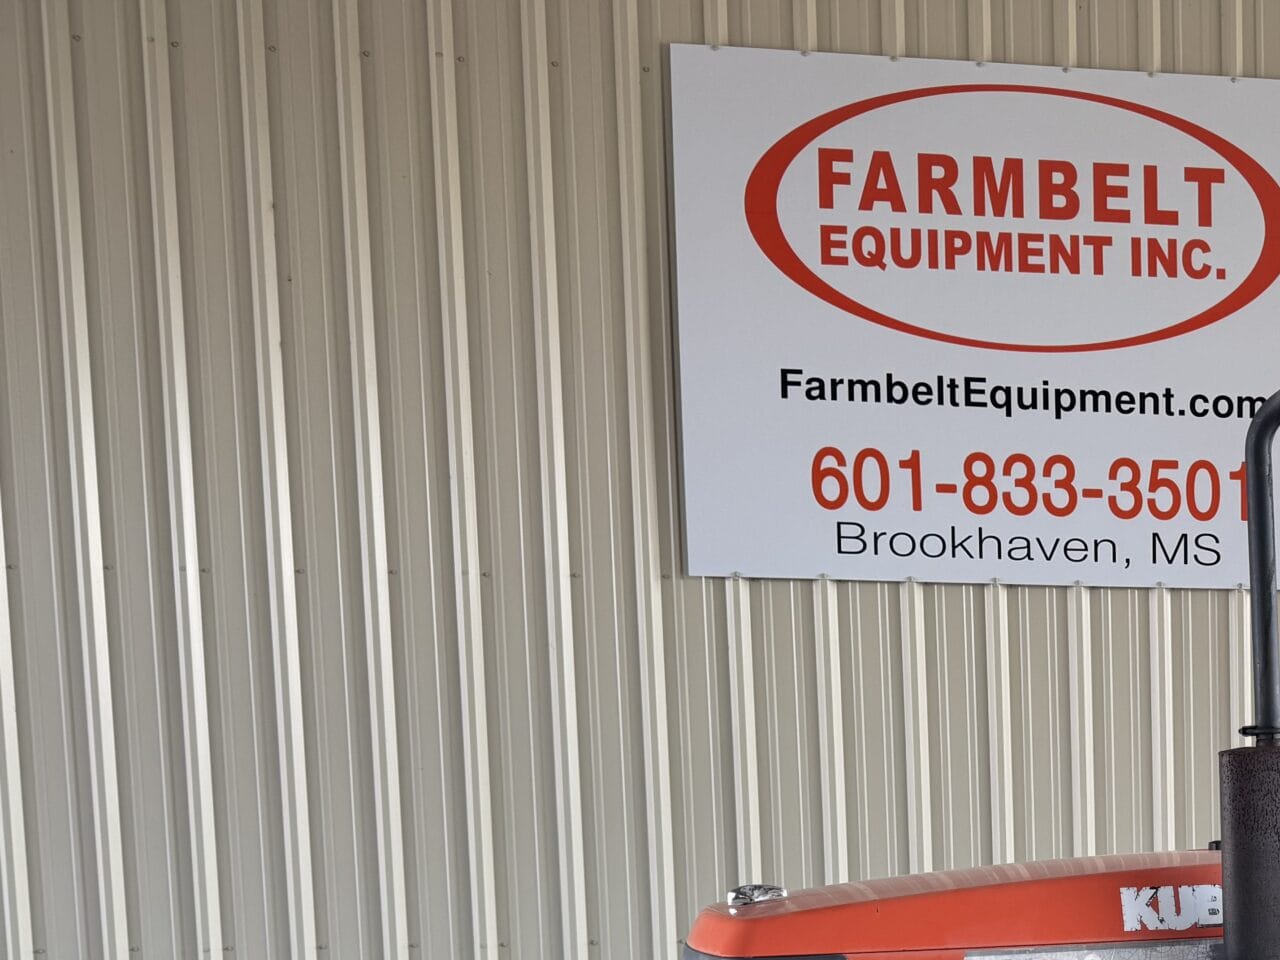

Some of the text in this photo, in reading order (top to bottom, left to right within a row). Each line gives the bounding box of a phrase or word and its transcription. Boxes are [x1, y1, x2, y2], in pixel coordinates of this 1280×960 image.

[816, 147, 1226, 227] FARMBELT
[820, 224, 1226, 280] EQUIPMENT INC.
[780, 368, 1268, 418] FarmbeltEquipment.com
[811, 446, 1249, 522] 601-833-3501
[836, 521, 1221, 569] Brookhaven, MS
